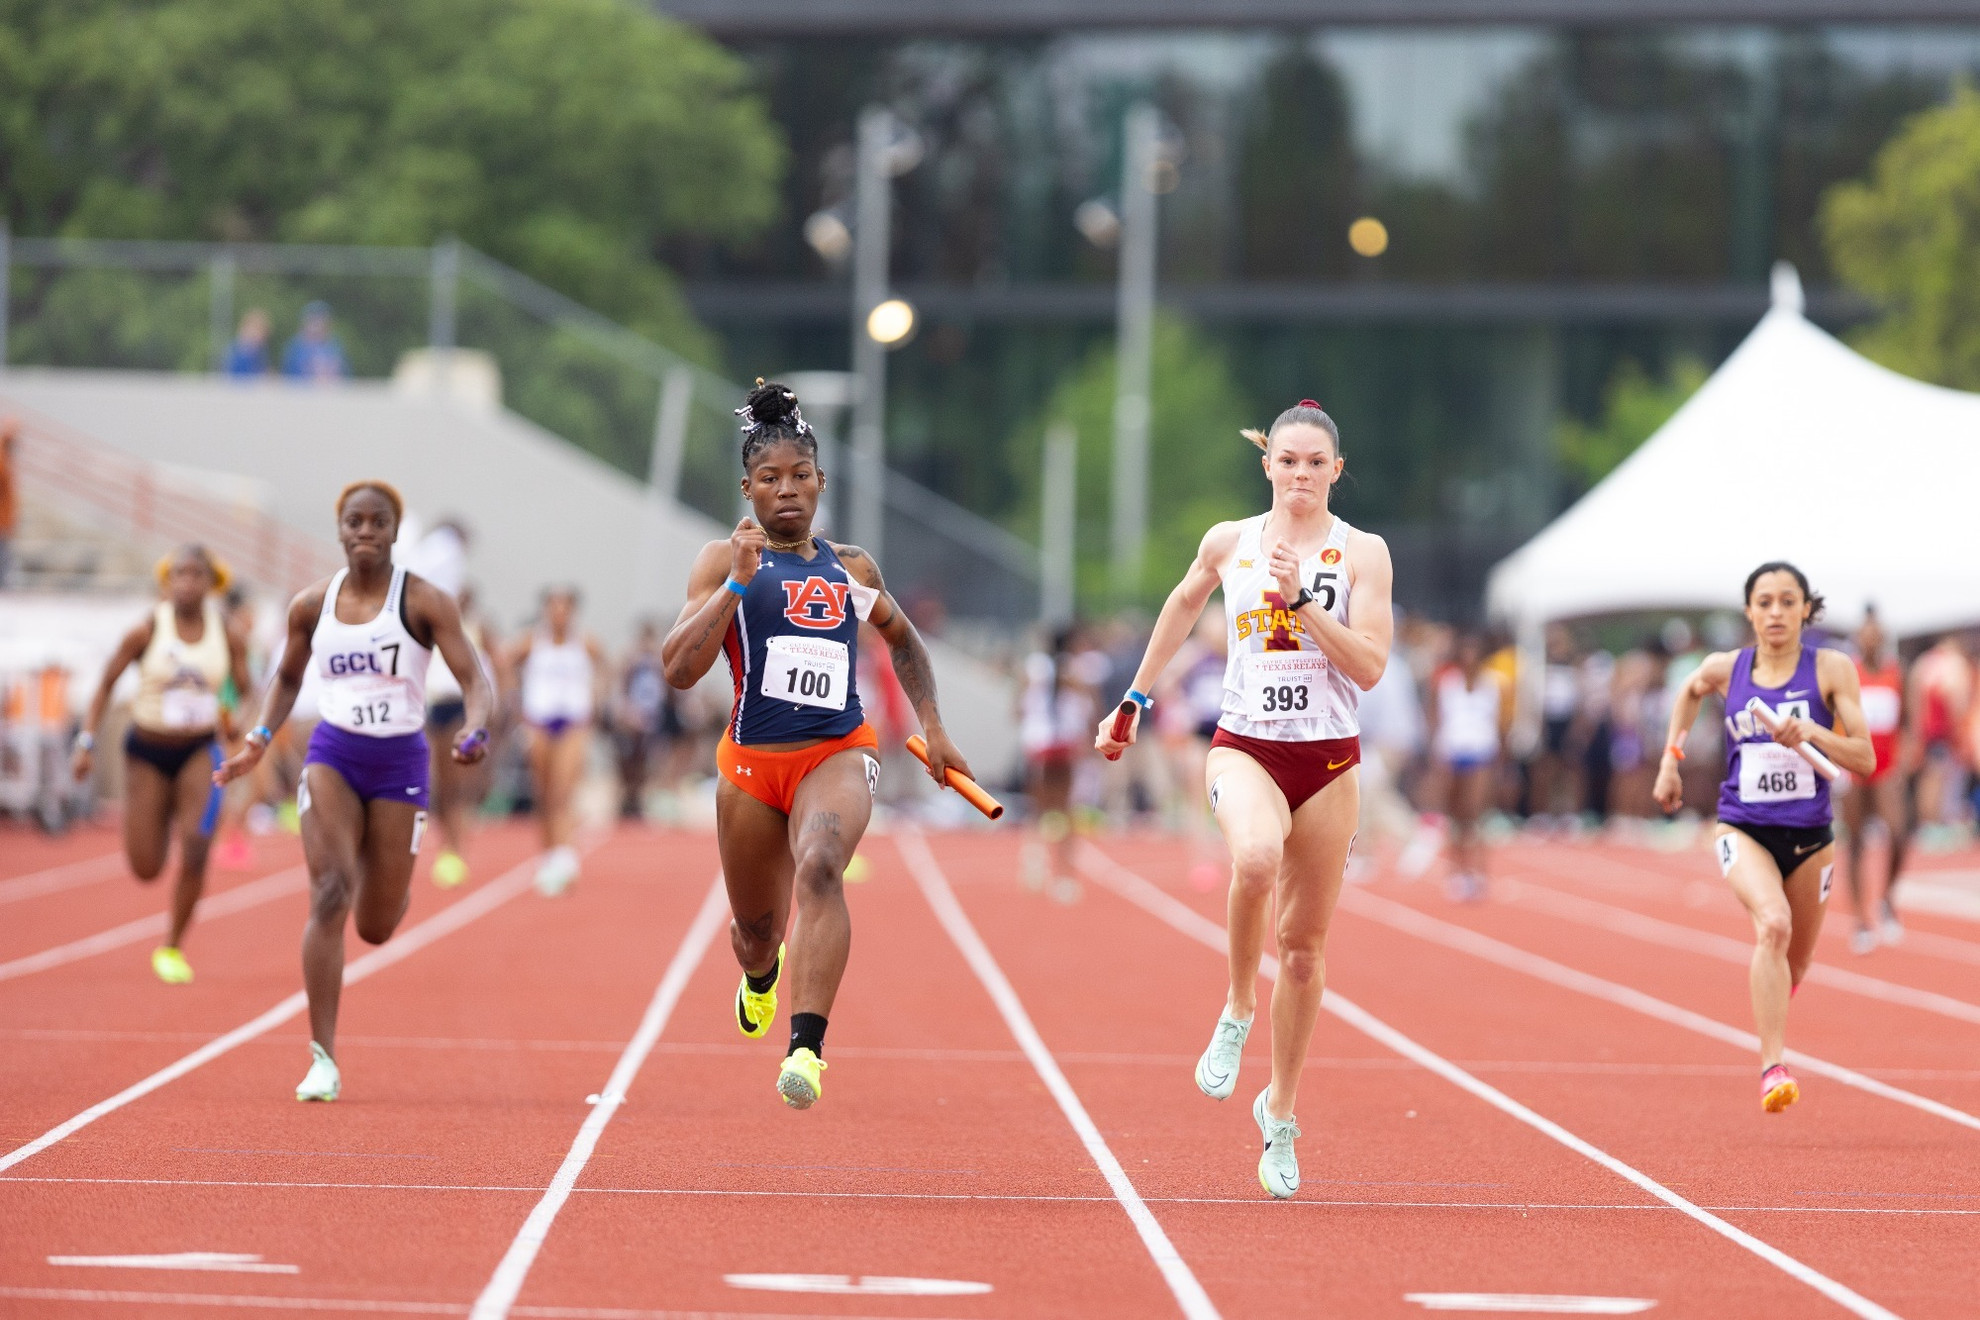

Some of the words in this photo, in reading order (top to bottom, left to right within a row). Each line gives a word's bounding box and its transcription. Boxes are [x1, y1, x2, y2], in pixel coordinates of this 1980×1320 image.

[1312, 572, 1337, 612] 5
[1236, 608, 1306, 641] STAT
[382, 643, 400, 676] 7
[1262, 663, 1292, 671] TEXAS
[1294, 662, 1327, 670] RELAYS
[787, 667, 831, 698] 100
[1263, 685, 1309, 712] 393
[352, 701, 390, 726] 312
[1758, 771, 1798, 793] 468
